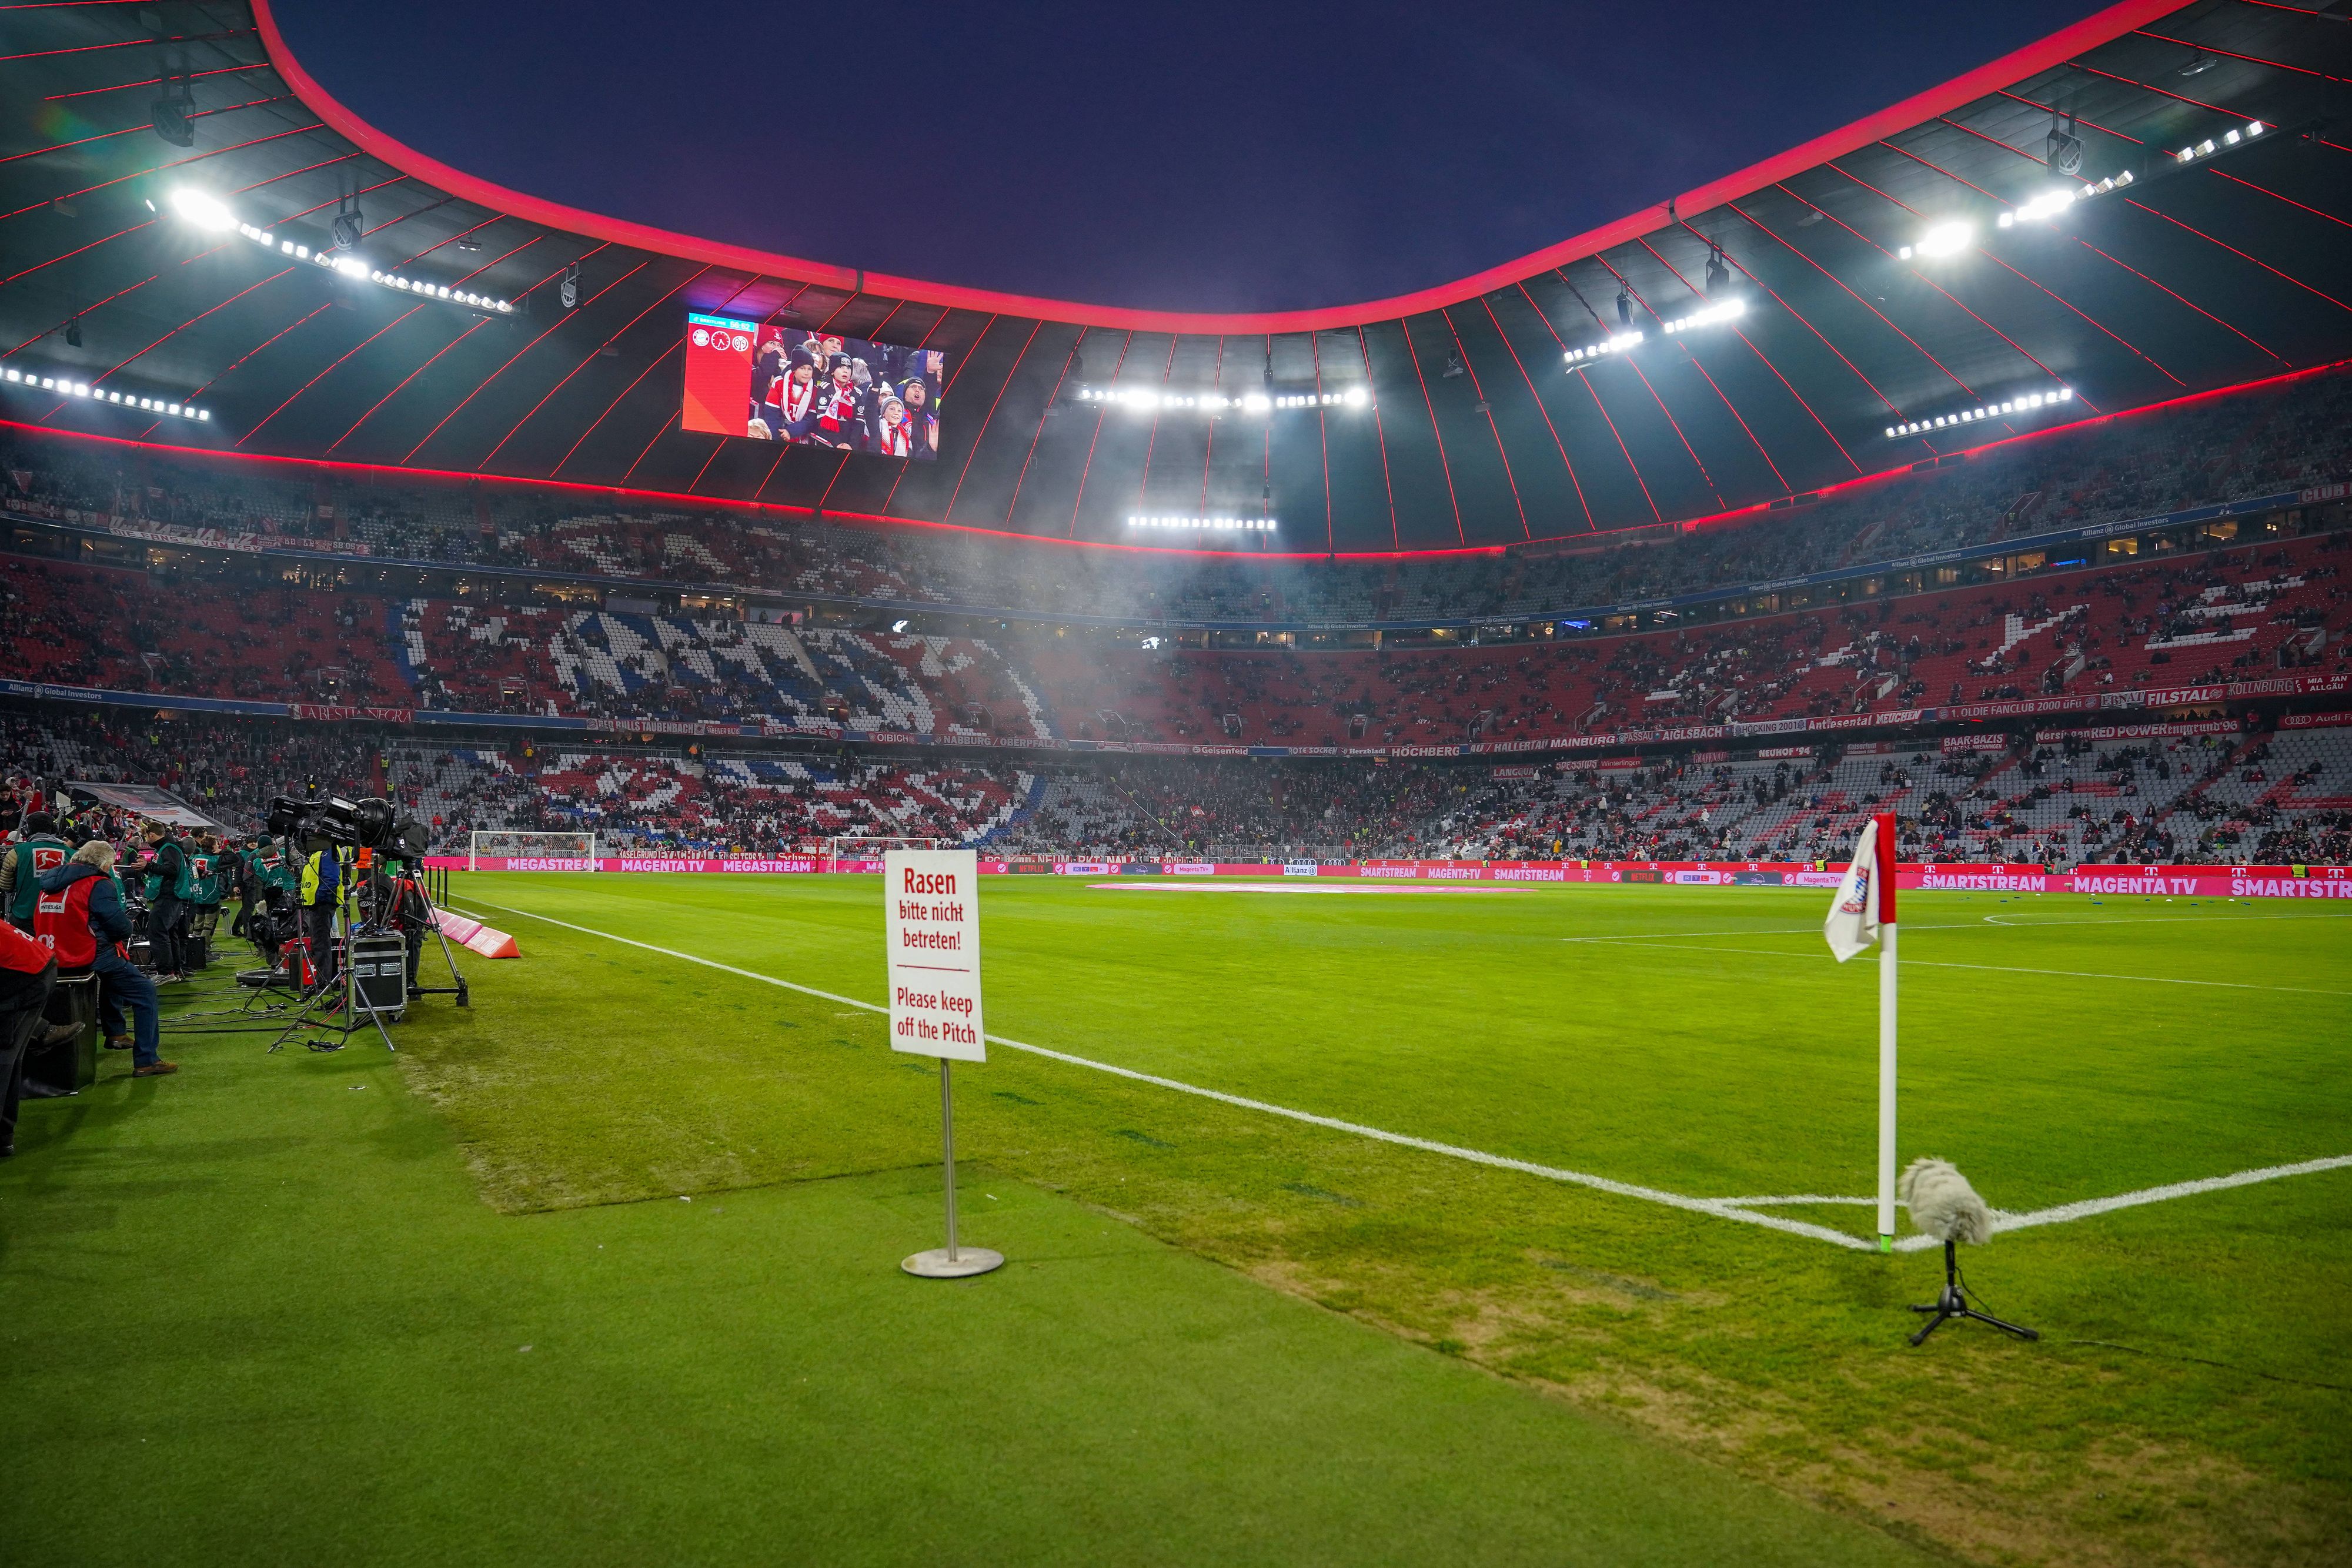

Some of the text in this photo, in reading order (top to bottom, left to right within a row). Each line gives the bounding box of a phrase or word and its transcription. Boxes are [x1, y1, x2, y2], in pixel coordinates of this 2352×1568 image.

[2301, 484, 2345, 503] CLUB
[2082, 517, 2169, 537] Allianz Global Investors
[114, 528, 135, 537] DIE
[141, 532, 179, 543] FANS
[202, 541, 229, 549] VOM
[1892, 551, 1961, 568] Allianz Global Investors
[8, 683, 102, 700] Allianz Global Investors
[2229, 680, 2294, 696] KOLLNBURG
[2310, 683, 2343, 691] ALLGÄU
[2102, 691, 2144, 706] EBNAT
[2147, 689, 2210, 706] FILSTAL
[300, 706, 317, 719] LA
[368, 709, 412, 723] NEGRA
[1961, 706, 1989, 717] OLDIE
[1991, 703, 2034, 715] FANCLUB
[2037, 700, 2060, 711] 2000
[2063, 699, 2082, 709] üFü
[1808, 715, 1872, 730] Antiesental
[2315, 713, 2341, 723] Audi
[616, 721, 640, 731] BULLS
[642, 721, 694, 734] TAUBENBACH
[707, 726, 727, 735] SÄBENER
[763, 726, 828, 736] REDSIDE
[1662, 727, 1722, 741] AIGLSBACH
[1742, 721, 1797, 734] HÖCKING 2001
[2091, 723, 2169, 738] RED POWER
[877, 733, 908, 743] OIBICH
[944, 736, 991, 746] NABBURG
[1000, 738, 1056, 748] OBERPFALZ
[1551, 735, 1616, 748] MAINBURG
[1625, 732, 1653, 742] PASSAU
[1944, 734, 2004, 747] BAAR-BAZIS
[1201, 746, 1248, 755] Geisenfeld
[1308, 747, 1338, 755] SOCKEN
[1392, 745, 1460, 757] HÖCHBERG
[1470, 743, 1485, 753] AU
[1494, 740, 1548, 753] HALLERTAU
[1759, 746, 1810, 757] NEUHOF '94
[1601, 760, 1641, 768] Winterlingen
[507, 858, 604, 870] MEGASTREAM
[622, 860, 705, 871] MAGENTA TV
[723, 861, 810, 872] MEGASTREAM
[1361, 867, 1564, 881] SMARTSTREAM MAGENTA TV SMARTSTREAM
[1631, 872, 1655, 882] NETFLIX
[1803, 876, 1829, 885] Magenta
[904, 867, 957, 895] Rasen
[1922, 875, 2046, 891] SMARTSTREAM
[2074, 877, 2197, 895] MAGENTA TV
[900, 900, 964, 922] bitte nicht
[903, 927, 961, 950] betreten!
[897, 987, 973, 1018] Please keep
[897, 1017, 977, 1044] off the Pitch
